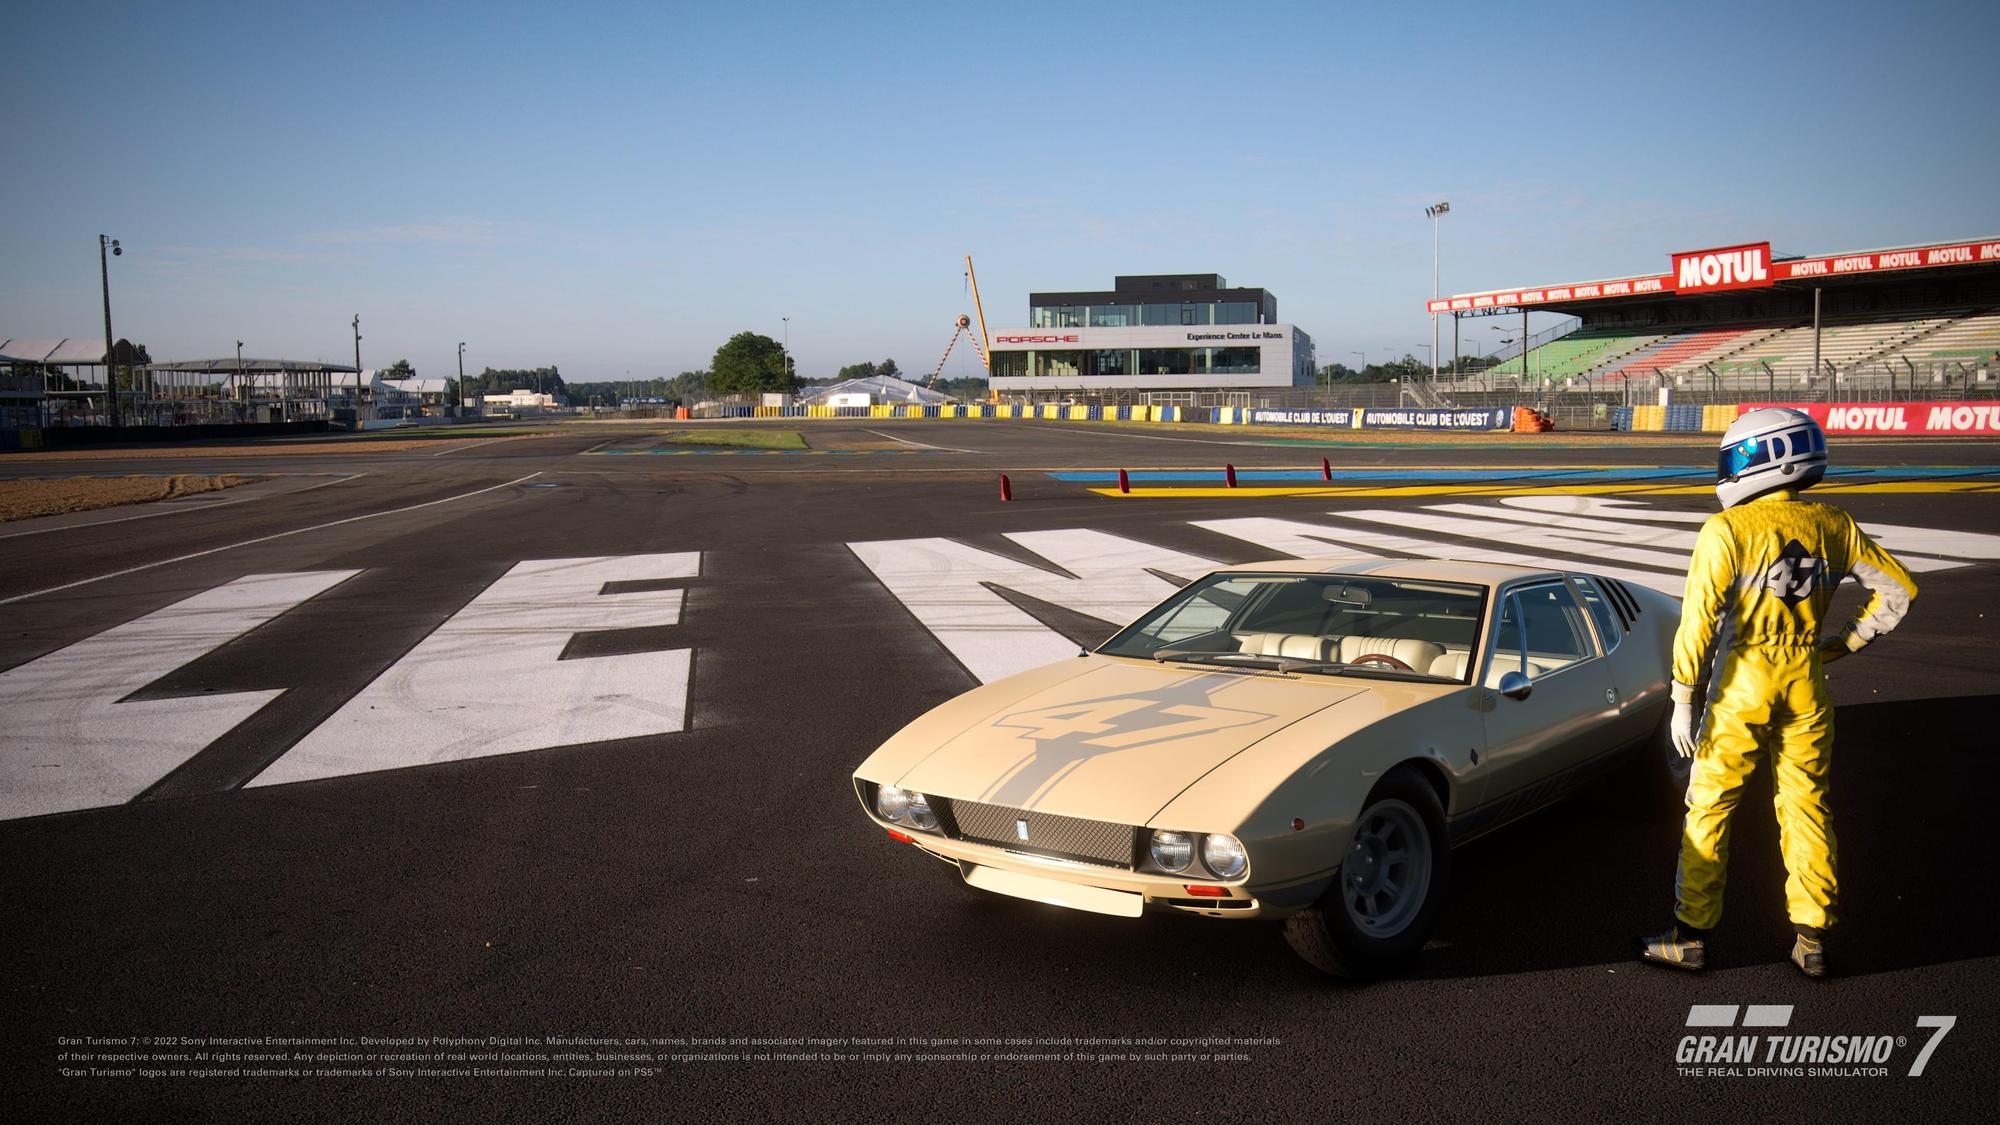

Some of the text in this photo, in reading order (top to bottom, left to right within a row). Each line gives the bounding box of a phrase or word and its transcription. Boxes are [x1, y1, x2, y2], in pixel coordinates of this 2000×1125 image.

[1679, 249, 1767, 288] MOTUL
[1791, 260, 1828, 275] MOTUL
[1833, 256, 1873, 273] MOTUL
[1879, 252, 1921, 268] MOTUL
[1928, 247, 1972, 263] MOTUL
[1497, 293, 1518, 304] MOTUL
[1521, 291, 1544, 303] MOTUL
[1547, 288, 1571, 300] MOTUL
[1575, 285, 1600, 297] MOTUL
[1603, 282, 1630, 295] MOTUL
[1634, 279, 1662, 292] MOTUL
[997, 335, 1079, 343] PORSCHE
[1187, 333, 1225, 341] Experience
[1263, 331, 1283, 339] Mans
[1255, 411, 1349, 424] AUTOMOBILE CLUB DE L'OUEST
[1366, 412, 1489, 426] AUTOMOBILE CLUB DE L'OUEST
[1826, 408, 1908, 430] MOTUL
[1760, 557, 1829, 598] 47
[0, 551, 703, 821] LE
[992, 698, 1276, 748] 47
